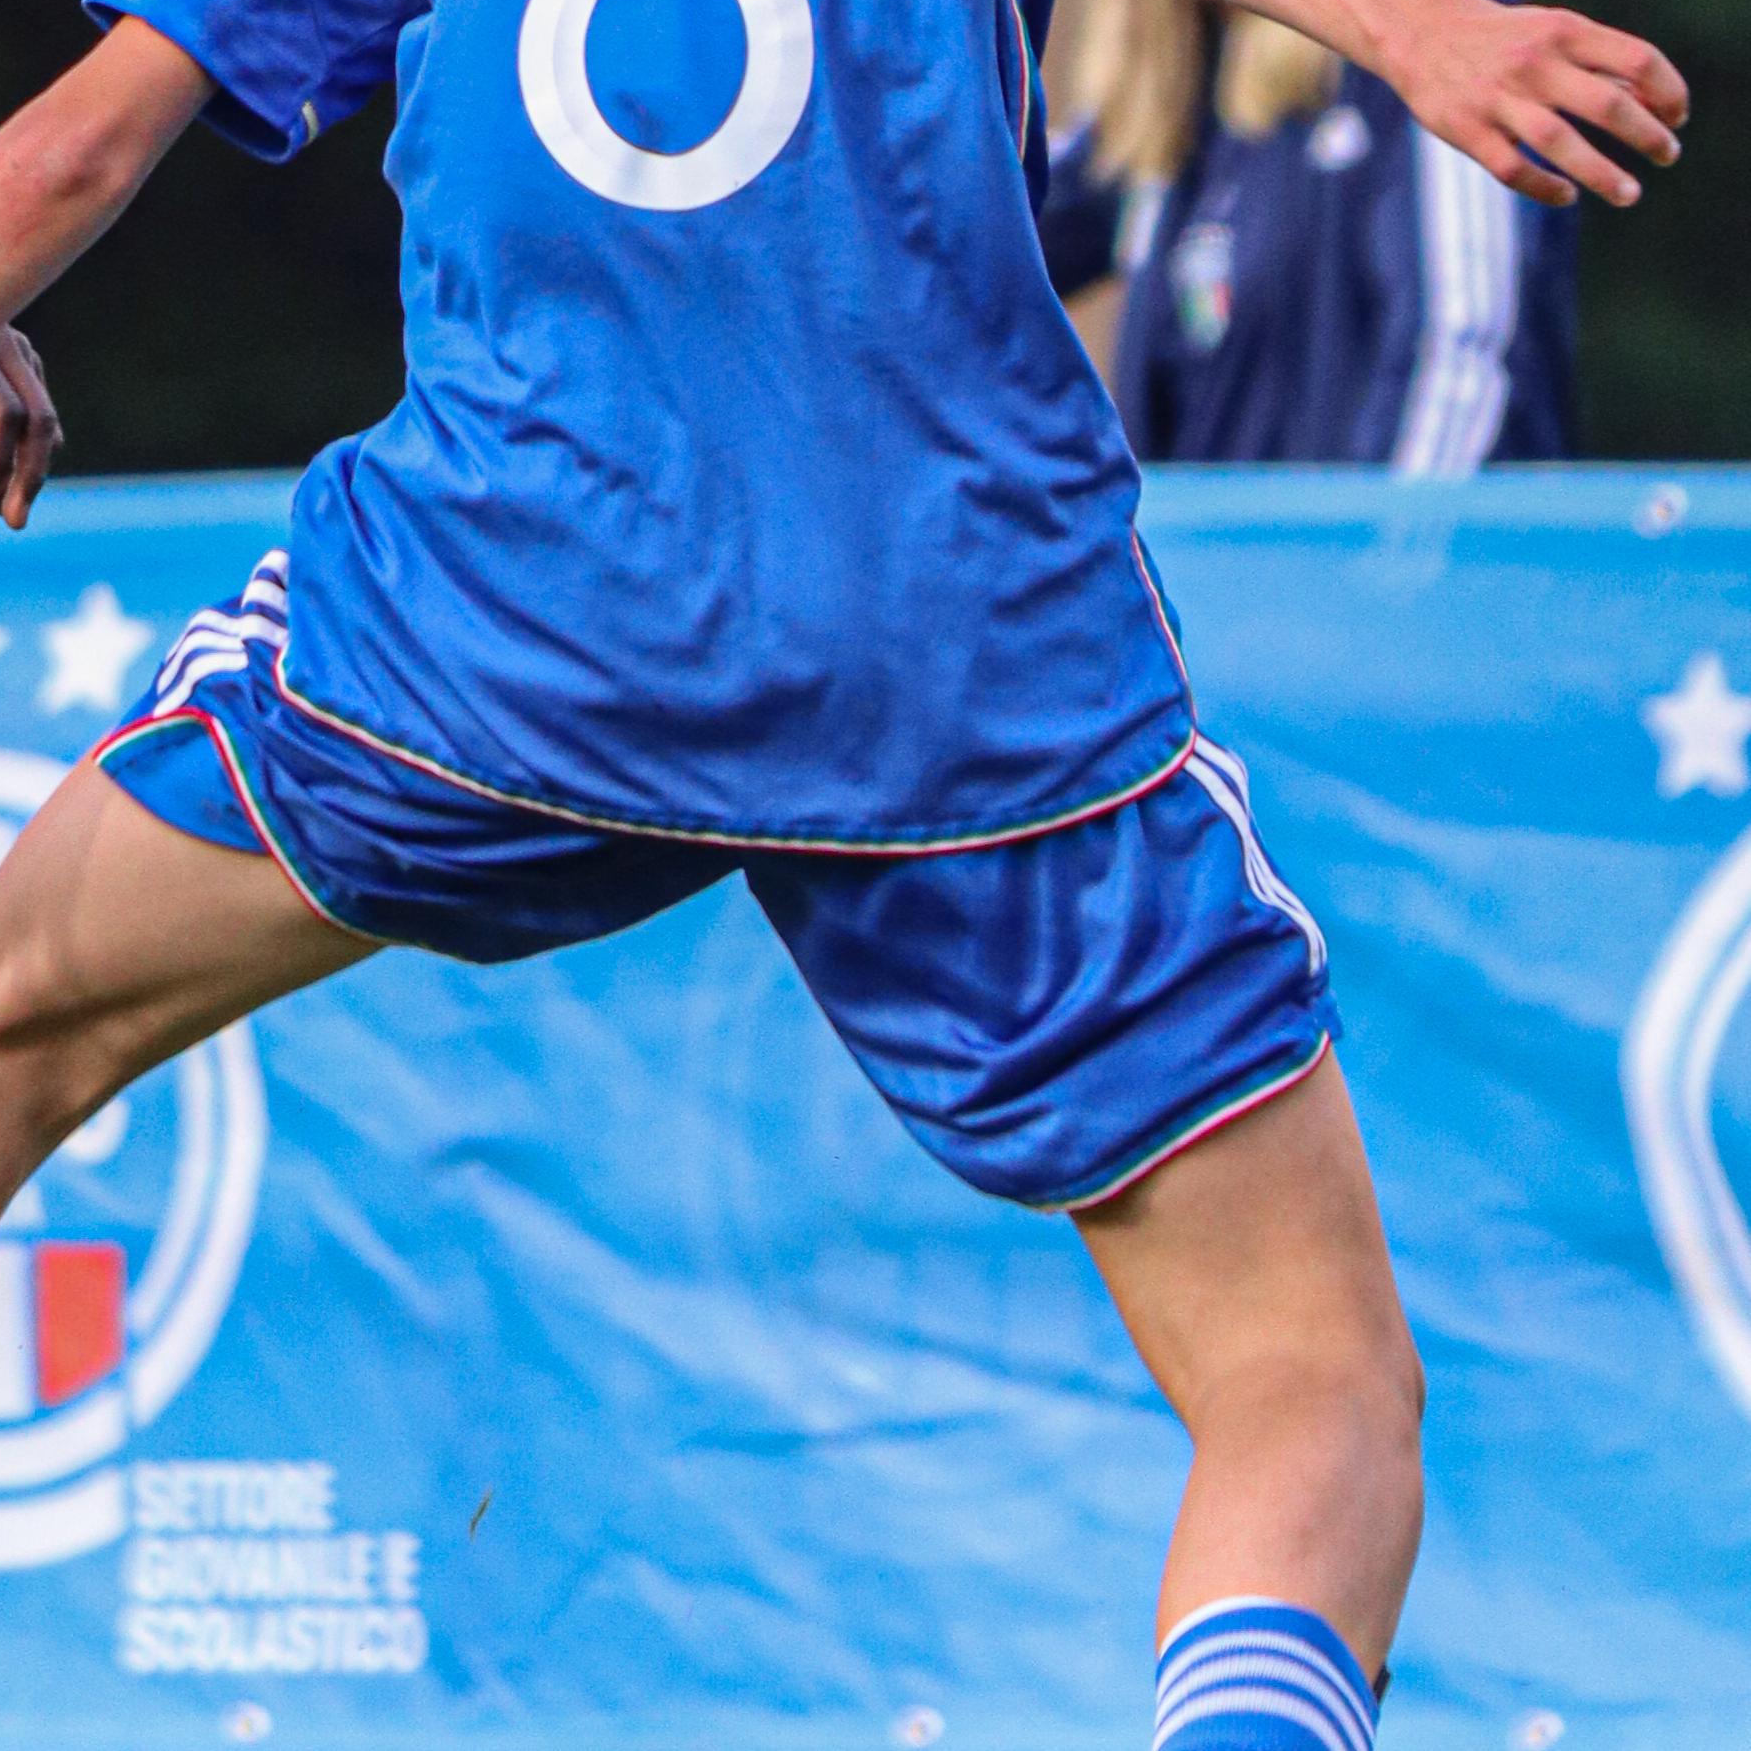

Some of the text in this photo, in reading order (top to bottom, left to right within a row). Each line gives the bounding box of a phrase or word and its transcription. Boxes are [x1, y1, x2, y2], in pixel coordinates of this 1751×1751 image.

[134, 1460, 336, 1530] SETTORE
[128, 1532, 420, 1602] GIOVANILE E
[119, 1605, 428, 1673] SCOLASTICO
